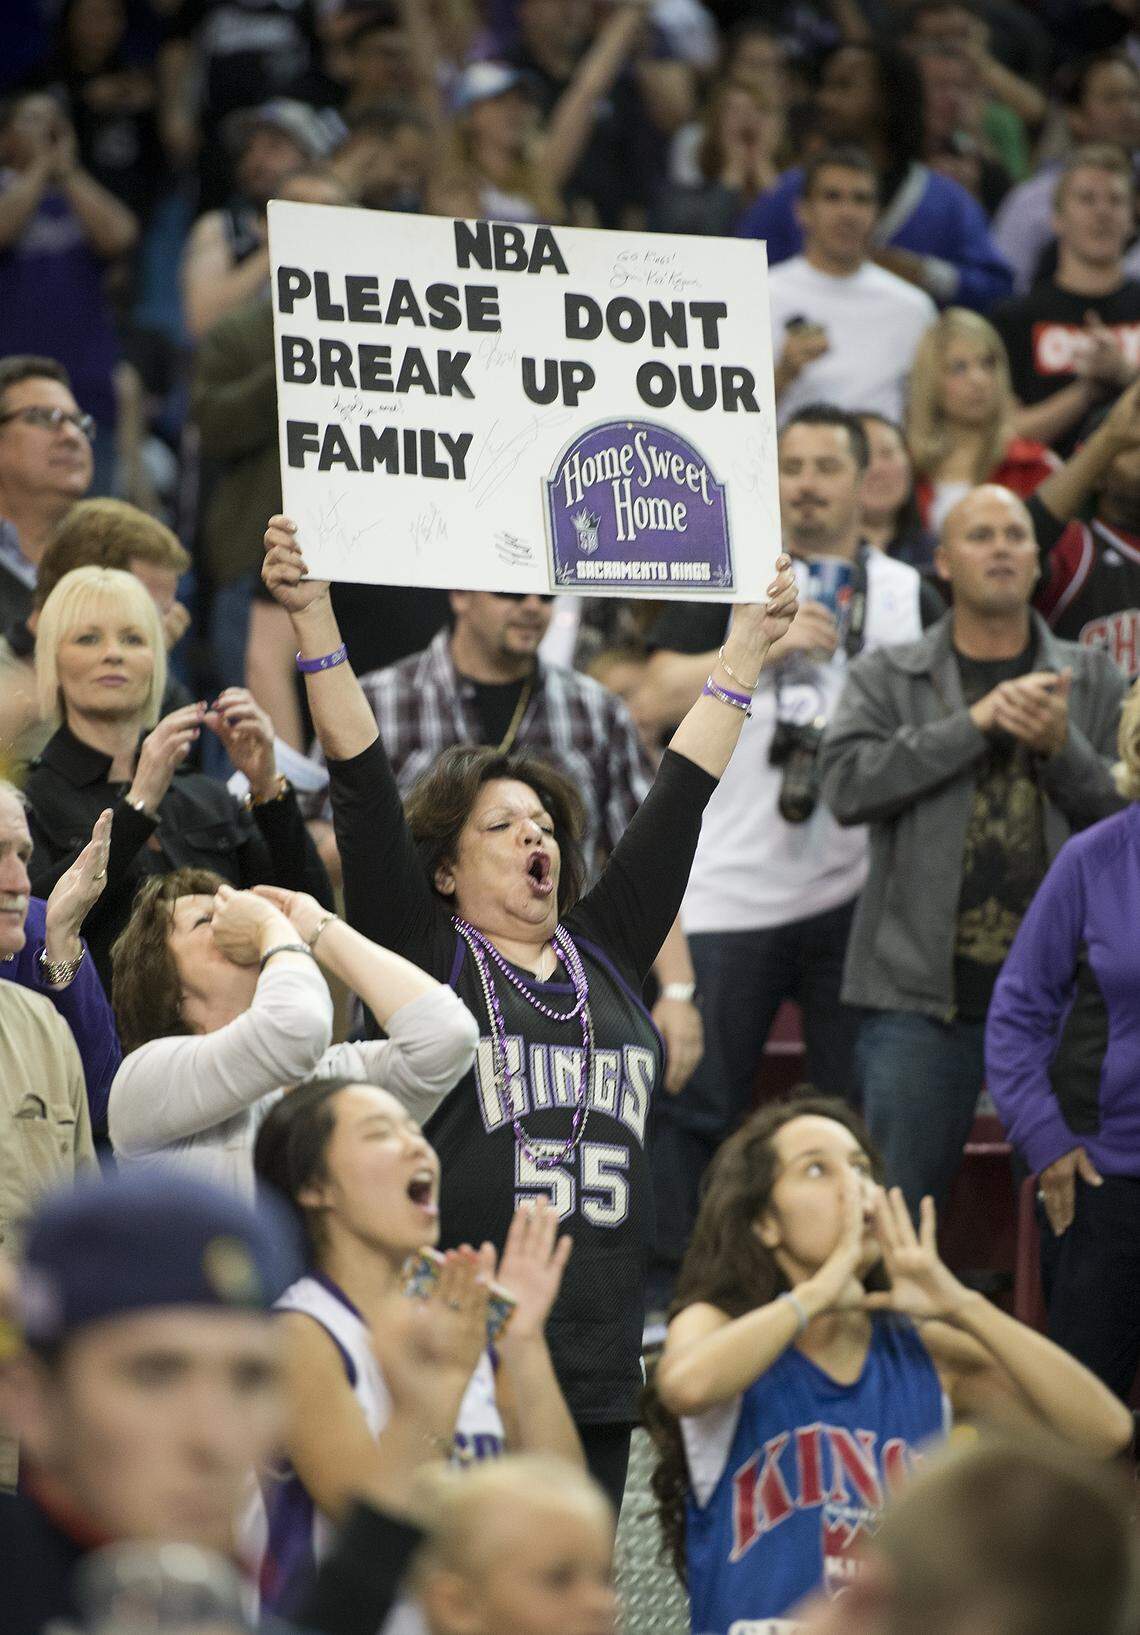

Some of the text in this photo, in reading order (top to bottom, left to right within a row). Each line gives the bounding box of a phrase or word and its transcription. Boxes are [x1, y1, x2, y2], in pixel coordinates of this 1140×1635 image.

[454, 219, 569, 275] NBA
[277, 265, 728, 350] PLEASE DONT
[281, 335, 476, 399] BREAK
[521, 357, 596, 407] UP
[636, 361, 761, 413] OUR
[286, 419, 474, 480] FAMILY
[562, 444, 635, 508] Home
[634, 431, 714, 506] Sweet
[611, 478, 688, 542] Home
[576, 560, 668, 580] SACRAMENTO
[474, 1034, 656, 1151] KINGS
[514, 1138, 631, 1229] 55
